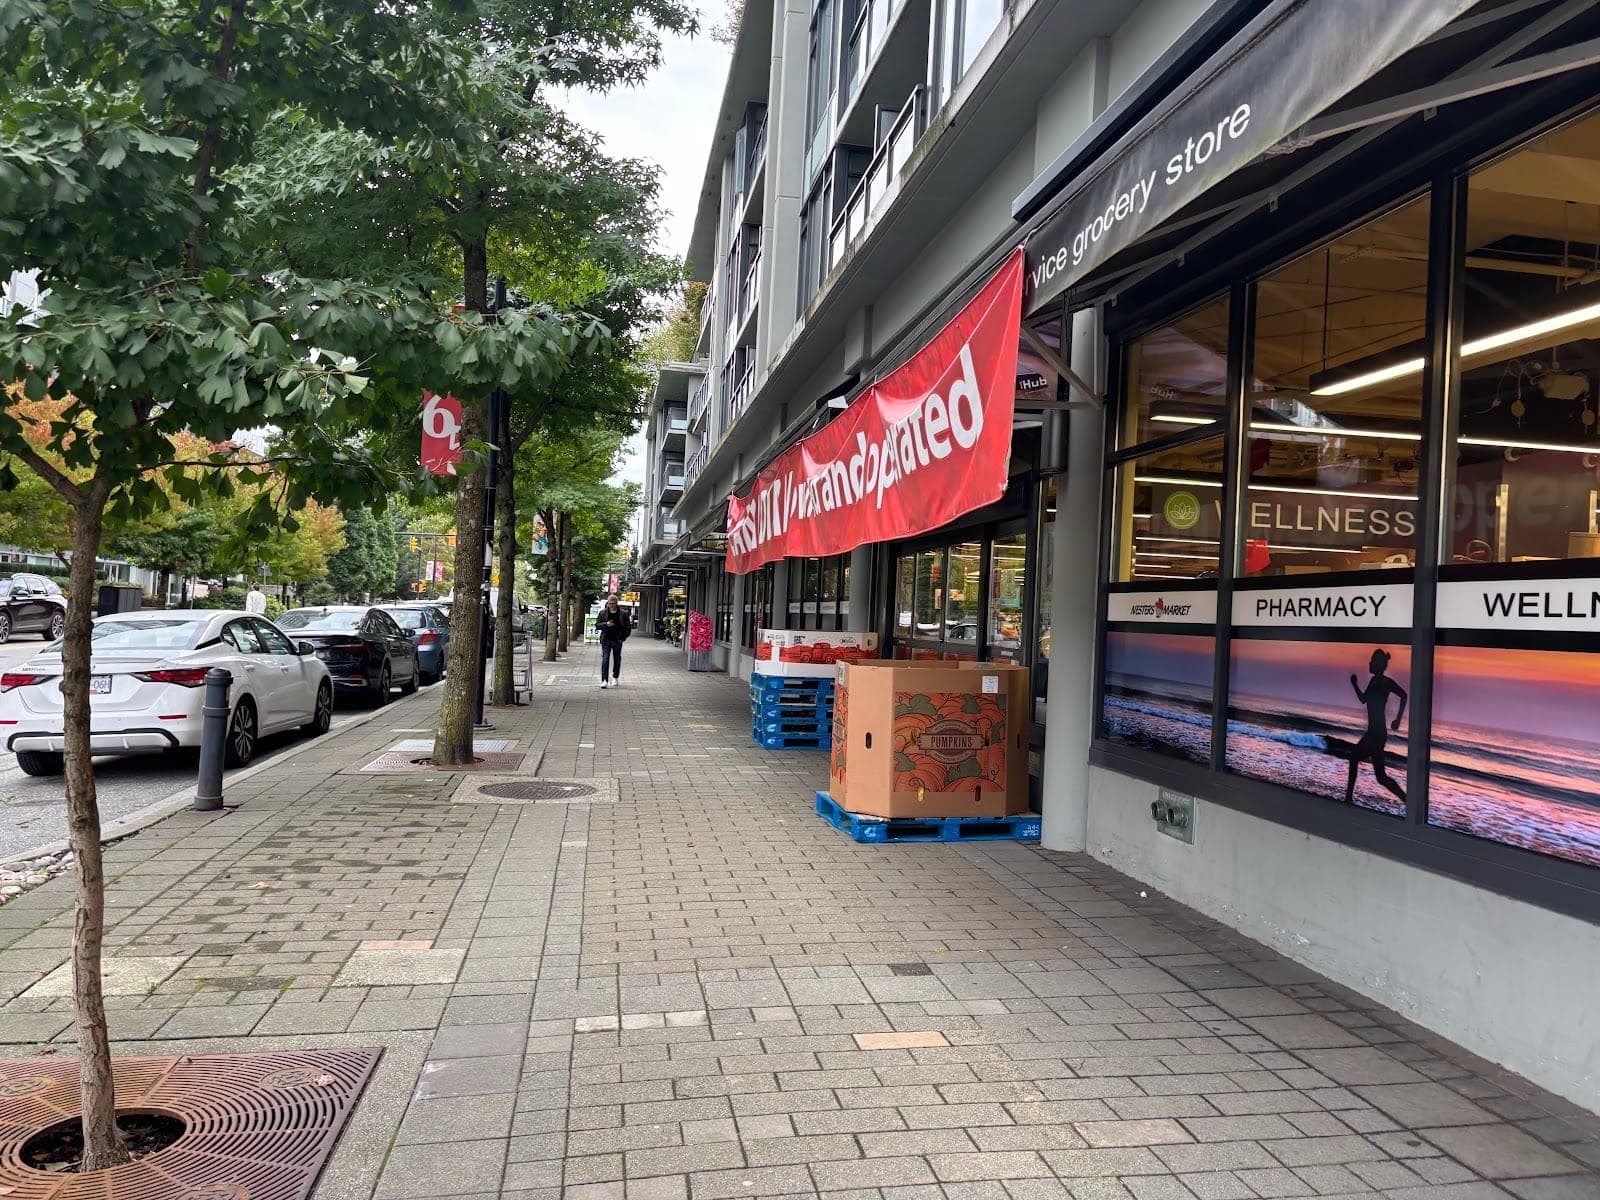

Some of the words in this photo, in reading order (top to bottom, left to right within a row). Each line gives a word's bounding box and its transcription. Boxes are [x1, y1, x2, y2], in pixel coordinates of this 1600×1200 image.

[1072, 170, 1157, 266] grocery
[1165, 103, 1251, 186] store
[1215, 500, 1416, 537] ELLNESS
[1130, 604, 1155, 616] NESTERS
[1162, 604, 1192, 616] MARKET
[1256, 595, 1386, 617] PHARMACY
[931, 736, 973, 748] PUMPKINS
